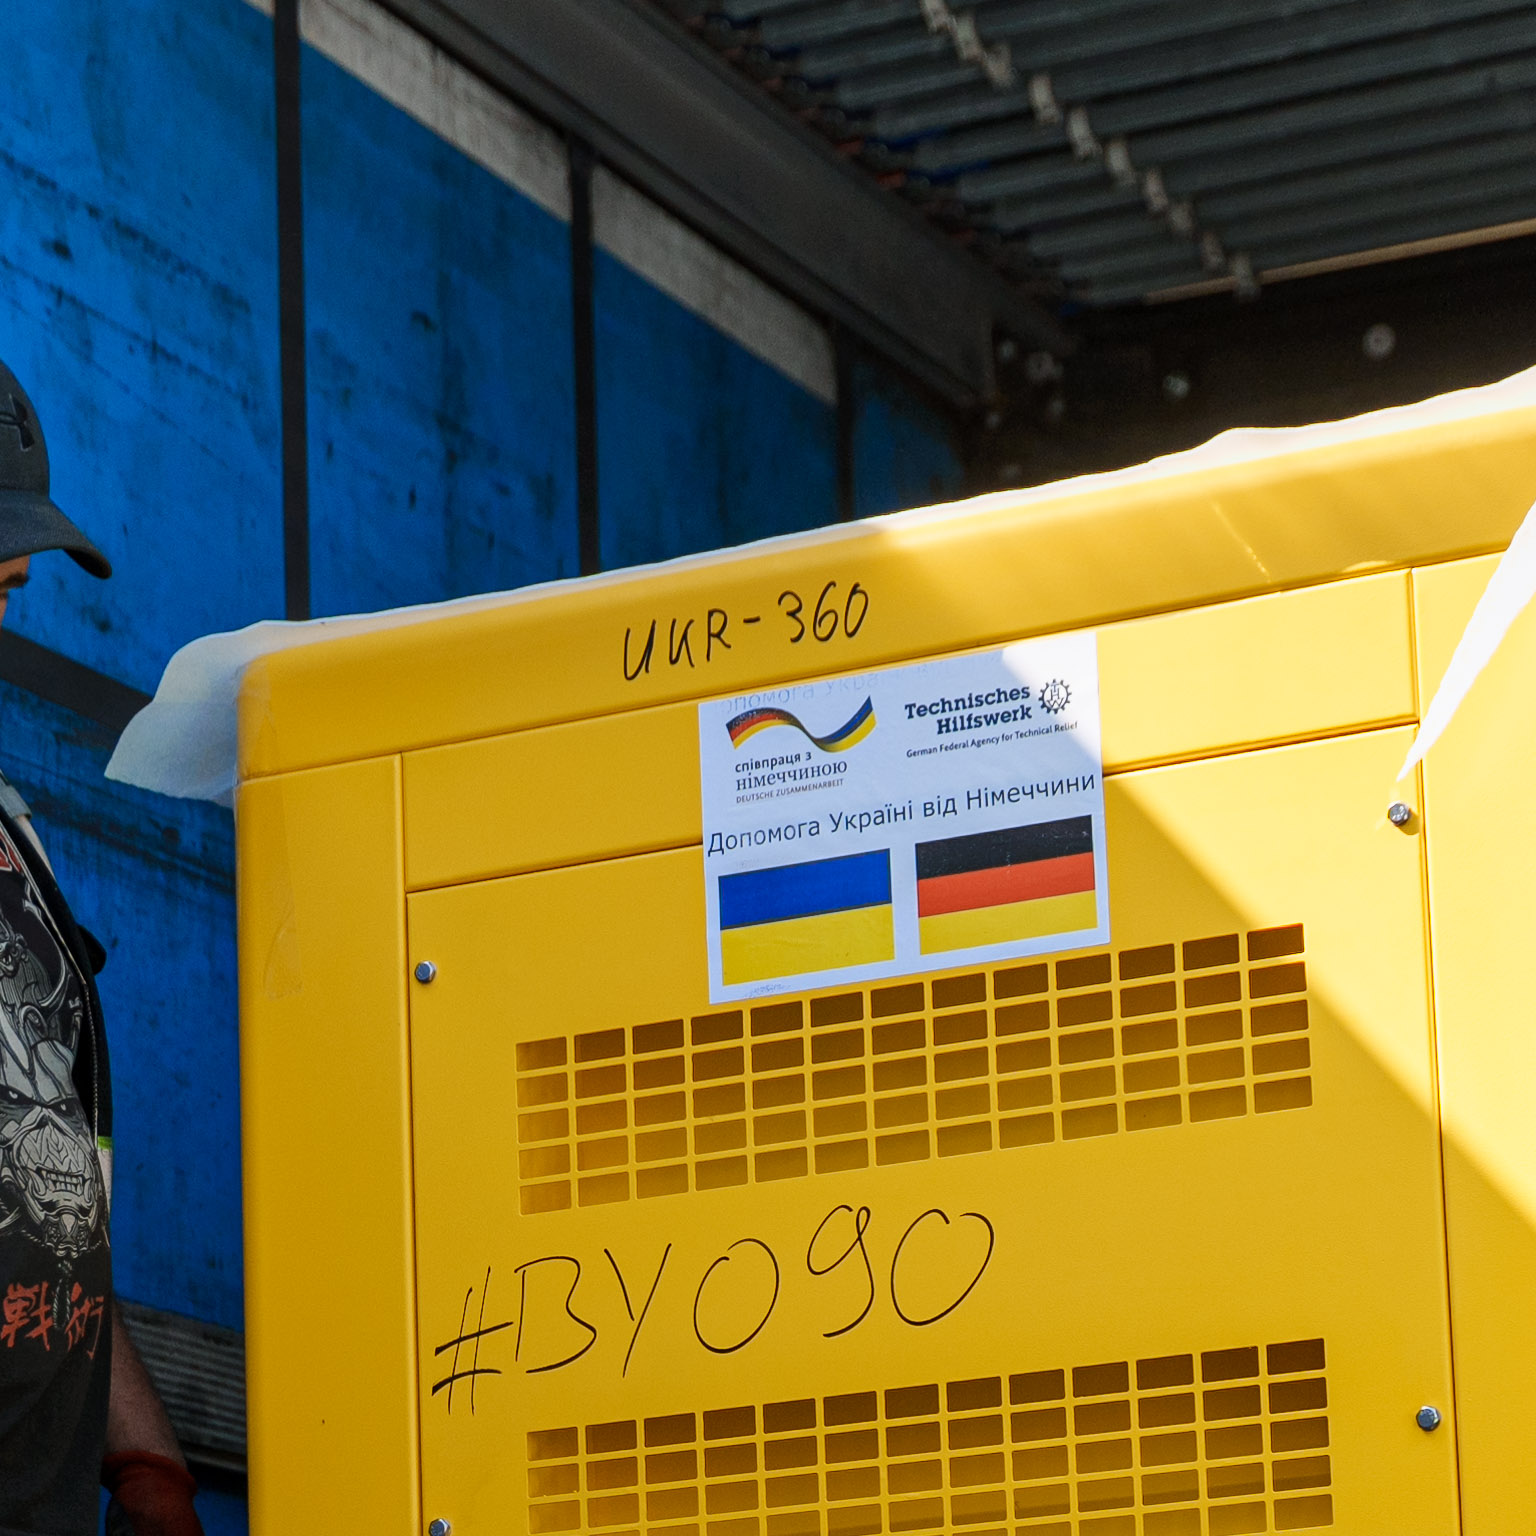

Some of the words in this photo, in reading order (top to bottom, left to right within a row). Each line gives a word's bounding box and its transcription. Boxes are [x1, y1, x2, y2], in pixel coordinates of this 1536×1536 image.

[904, 685, 1031, 720] Technisches
[936, 704, 1032, 735] Hilfswerk
[906, 746, 938, 758] German
[939, 740, 969, 753] Federal
[970, 735, 1000, 749] Agency
[1001, 733, 1013, 743] for
[1014, 724, 1053, 740] Technical
[1054, 721, 1078, 732] Relief
[735, 752, 801, 773] співпраця
[805, 751, 812, 761] з
[736, 760, 848, 791] німеччиною
[736, 790, 774, 804] DEUTSCHE
[775, 778, 844, 797] ZUSAMMENARBEIT
[707, 820, 820, 857] Допомога
[829, 800, 913, 833] Україні
[923, 795, 958, 818] від
[966, 774, 1095, 810] Німеччини
